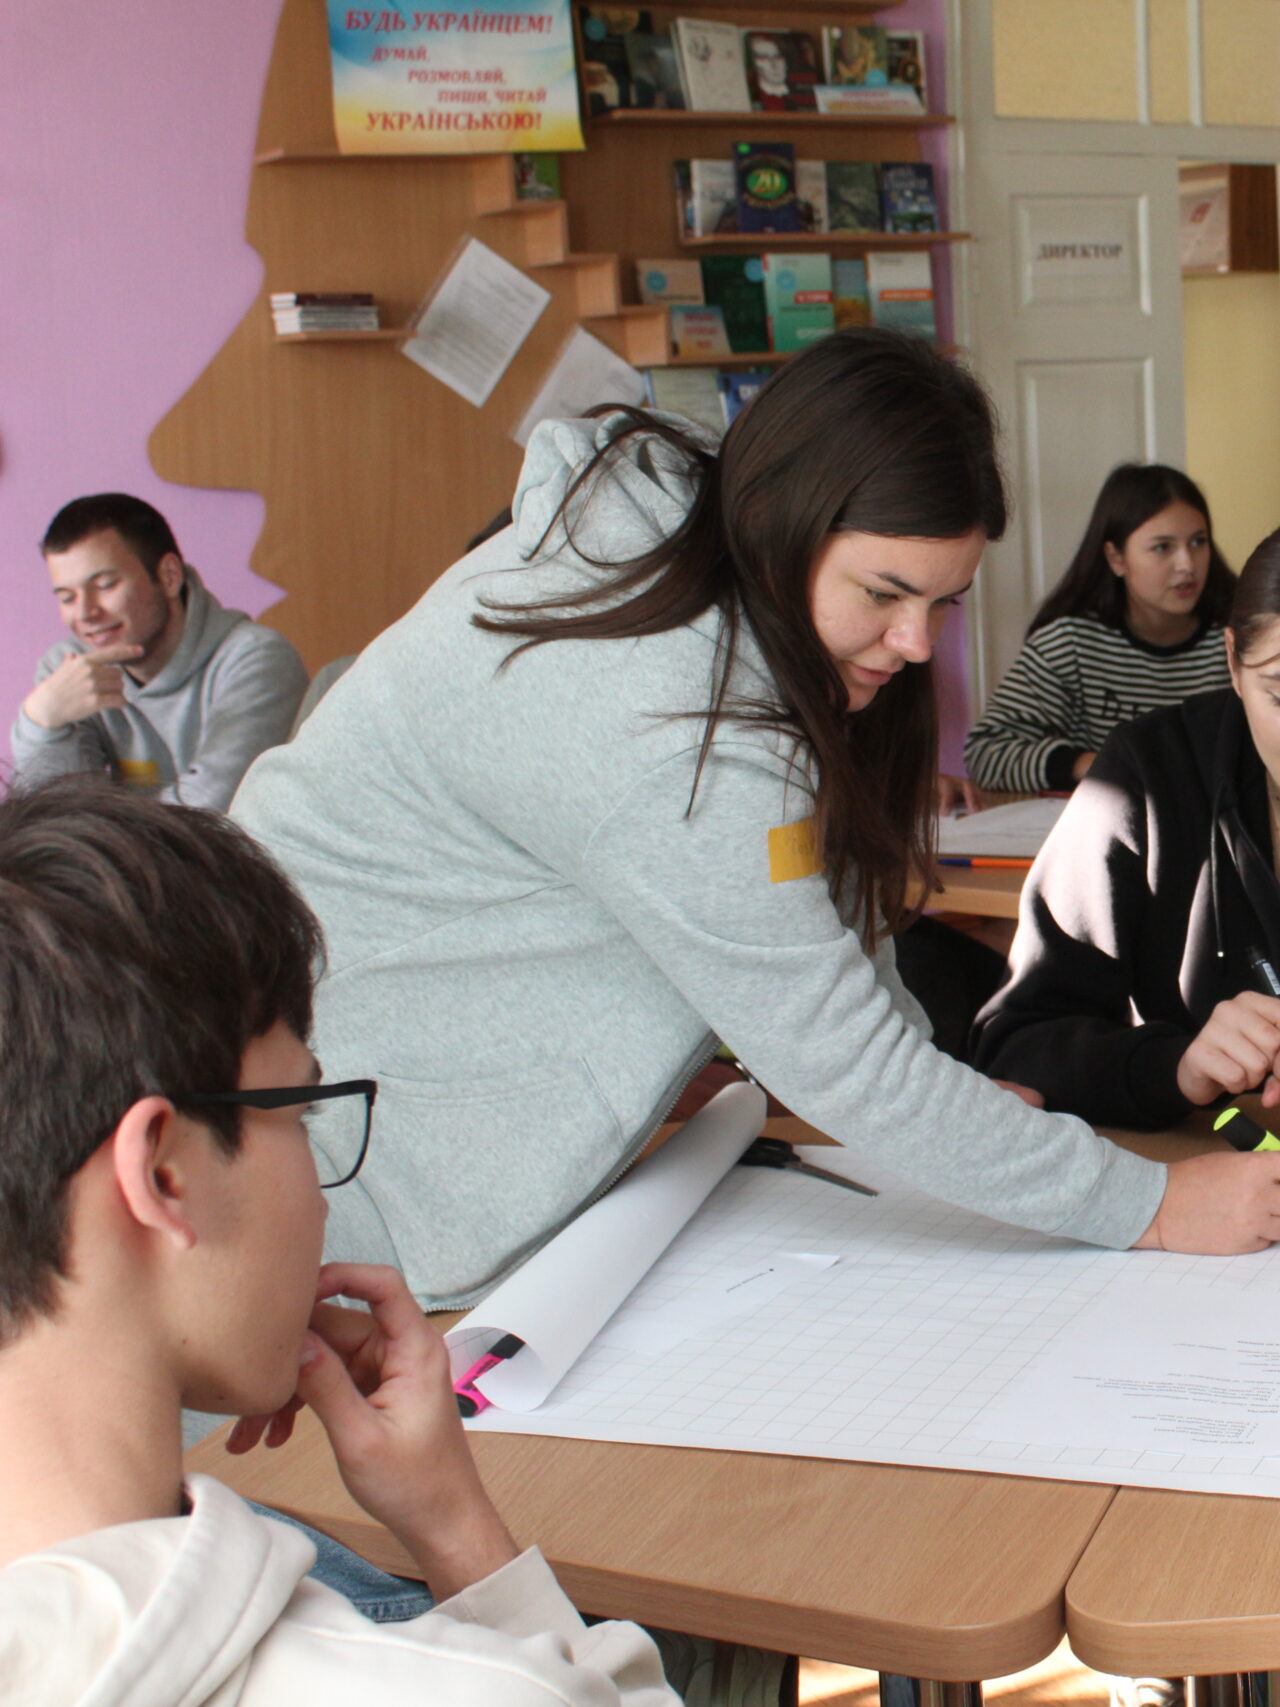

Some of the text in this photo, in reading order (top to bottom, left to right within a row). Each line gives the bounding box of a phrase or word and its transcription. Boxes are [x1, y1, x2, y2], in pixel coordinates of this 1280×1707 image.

[345, 10, 554, 34] БУДЬ УКРАЇНЦЕМ!
[370, 46, 431, 63] ДУМАЙ,
[407, 68, 507, 85] РОЗМОВЛЯЙ,
[494, 87, 548, 104] ЧИТАЙ
[366, 110, 543, 132] УКРАЇНСЬКОЮ!
